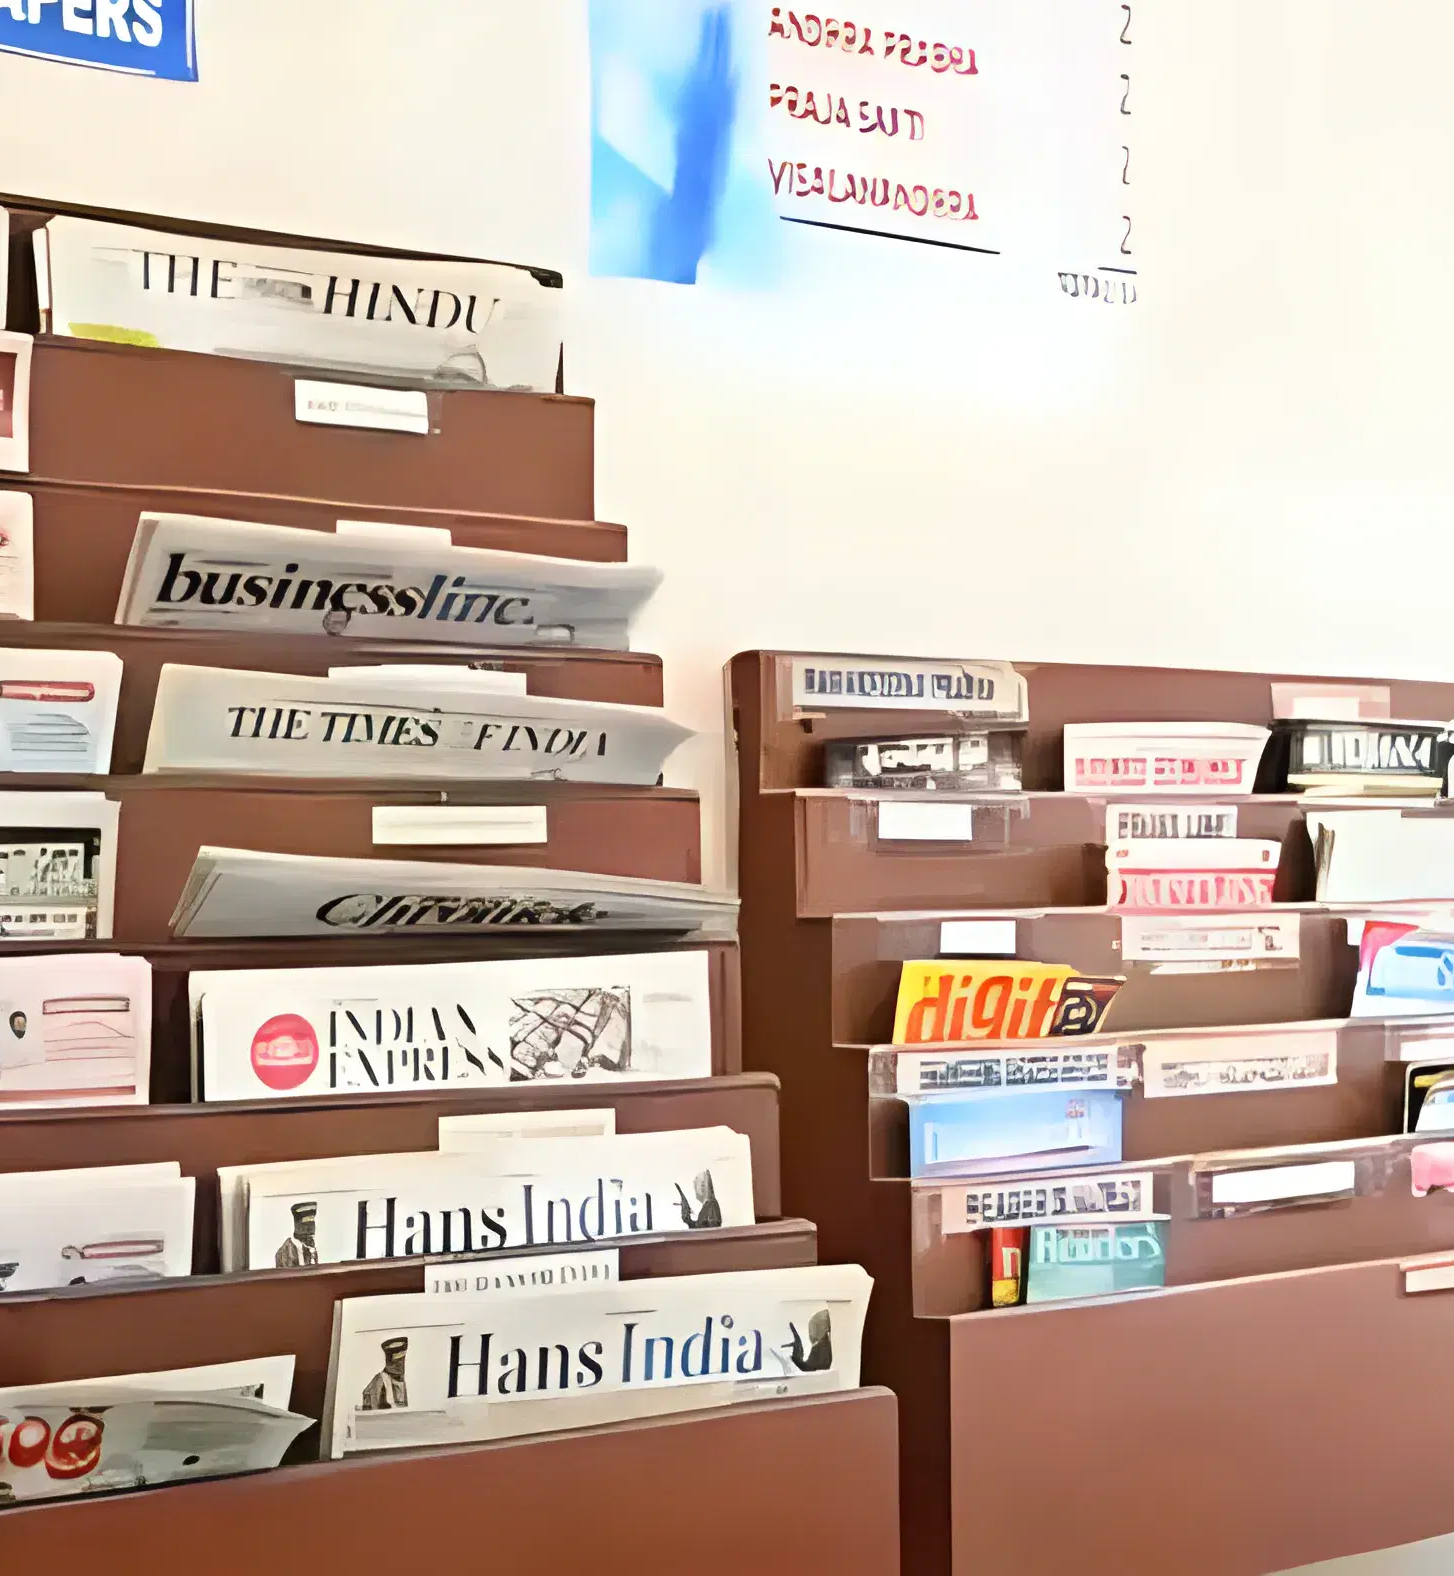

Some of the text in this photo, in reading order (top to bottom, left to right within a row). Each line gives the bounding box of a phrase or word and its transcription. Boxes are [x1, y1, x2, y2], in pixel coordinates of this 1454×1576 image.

[322, 275, 500, 335] HINDU
[356, 1178, 653, 1259] Hans India
[448, 1314, 763, 1399] Hans India
